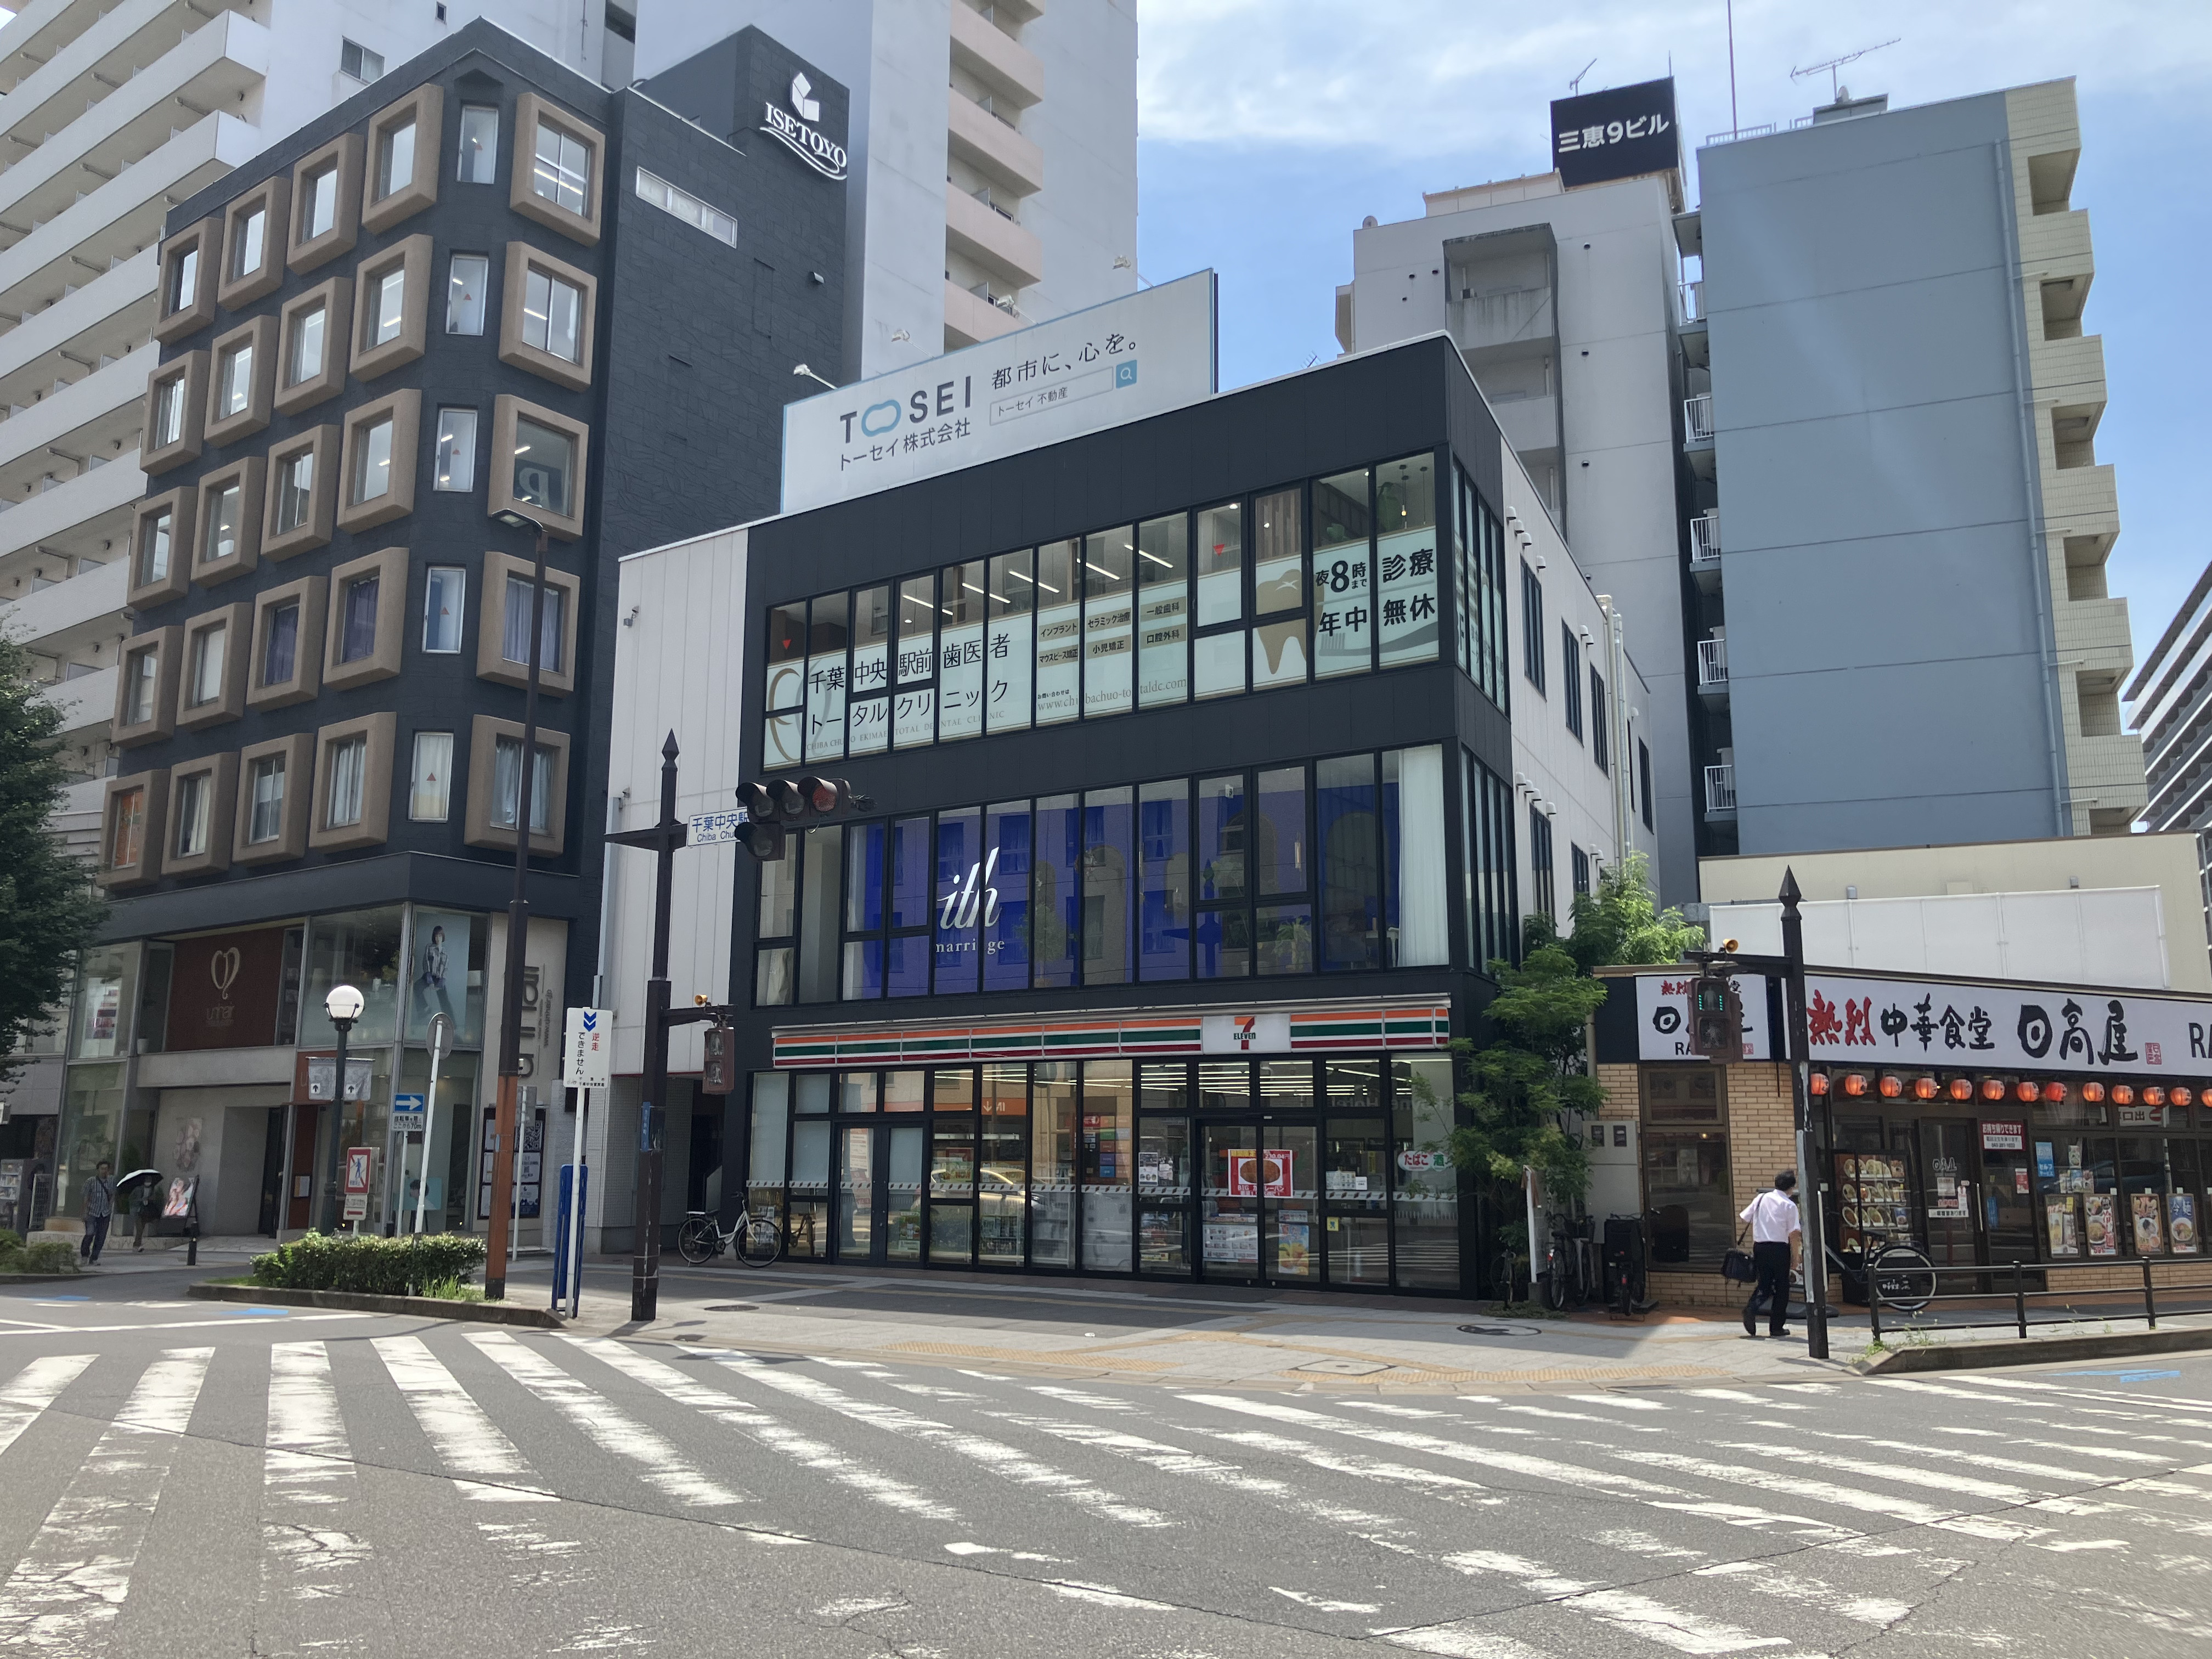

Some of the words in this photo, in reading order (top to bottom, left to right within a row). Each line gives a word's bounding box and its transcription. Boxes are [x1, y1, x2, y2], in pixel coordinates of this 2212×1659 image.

[765, 101, 848, 168] ISETOYO
[1558, 113, 1670, 153] 三恵9ビル
[992, 333, 1137, 390] 都市に、心を。
[840, 375, 973, 443] TOSEI
[998, 396, 1034, 416] トーセイ
[1037, 386, 1069, 405] 不動産
[839, 417, 972, 471] トーセイ株式会社
[1147, 601, 1180, 616] 一般歯科
[1319, 594, 1435, 637] 年中無休
[1041, 623, 1077, 637] インプラント
[1092, 640, 1125, 654] 小児矯正
[1147, 629, 1180, 644] 口腔外科
[808, 633, 1011, 695] 千葉中央駅前歯医者
[811, 679, 1008, 736] トータルクリニック
[895, 725, 920, 736] TOTAL
[697, 833, 716, 842] Chiba
[935, 939, 1006, 955] marrige
[591, 1032, 600, 1052] 逆走
[1807, 989, 1876, 1046] 熱烈
[1880, 992, 1996, 1053] 中華食堂
[2017, 998, 2138, 1066] 日高屋
[2188, 1022, 2212, 1059] R
[575, 1032, 586, 1075] できません
[1404, 1153, 1429, 1166] たばこ
